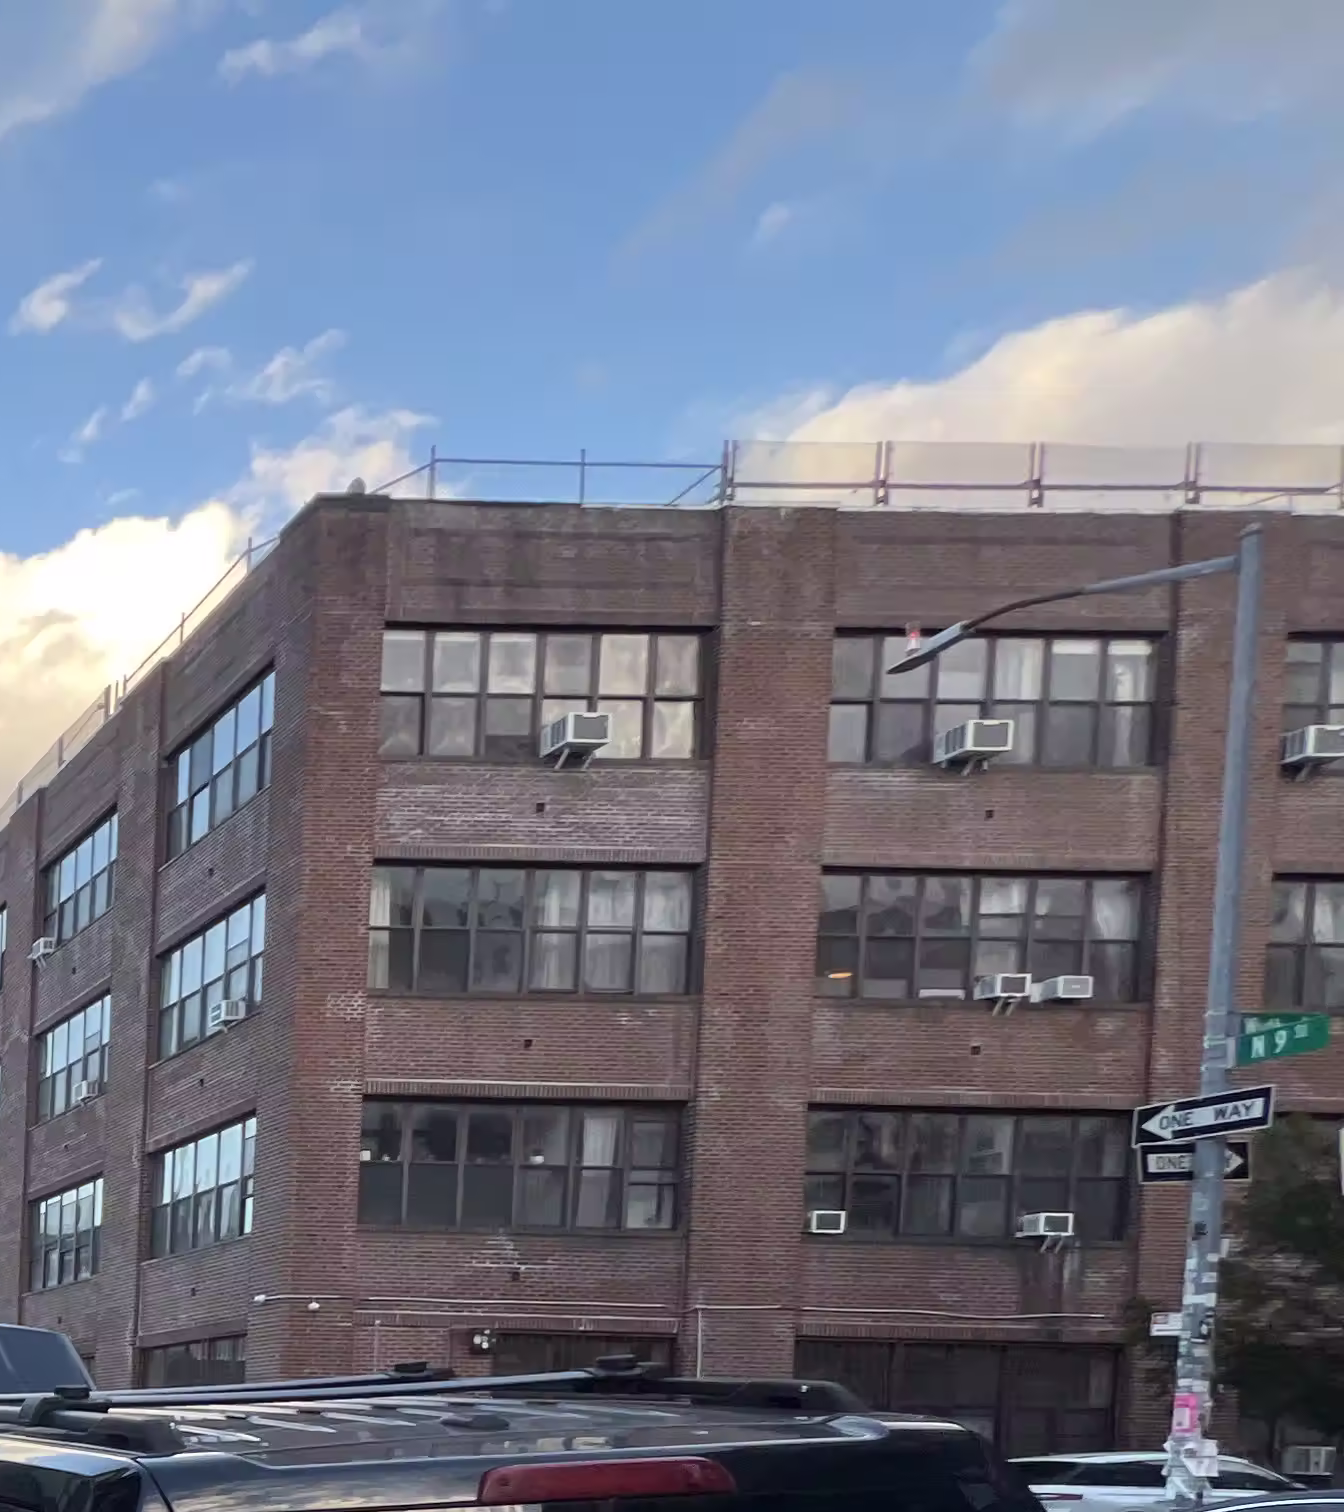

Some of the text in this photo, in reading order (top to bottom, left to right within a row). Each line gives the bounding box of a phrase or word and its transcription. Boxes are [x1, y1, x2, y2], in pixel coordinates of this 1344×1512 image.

[1273, 1030, 1287, 1054] 9
[1159, 1101, 1255, 1131] ONE WAY
